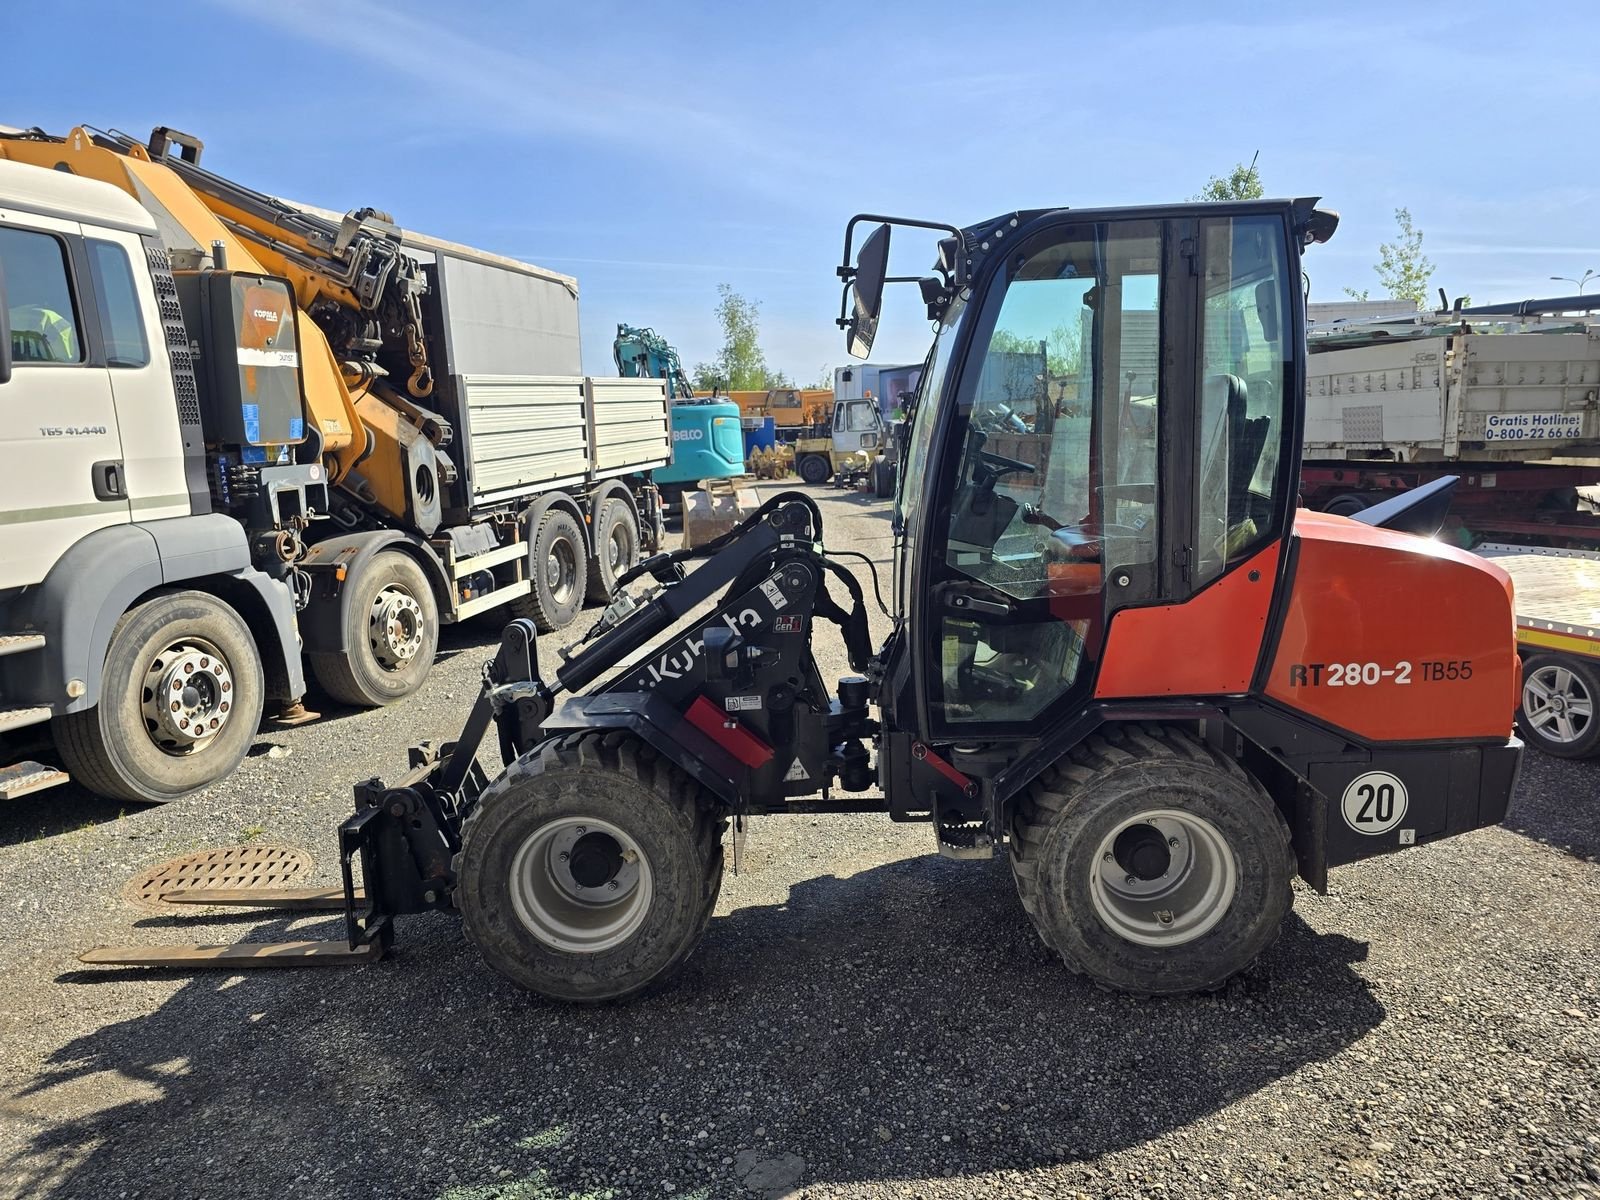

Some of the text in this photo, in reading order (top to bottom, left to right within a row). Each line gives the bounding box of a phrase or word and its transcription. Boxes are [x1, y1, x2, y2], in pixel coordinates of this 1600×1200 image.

[1489, 415, 1528, 426] Gratis
[1532, 414, 1580, 426] Hotline:
[40, 426, 106, 436] TGS 41.440
[1486, 427, 1580, 440] 0-800-22 66 66
[647, 608, 763, 684] Kubta
[1421, 661, 1473, 682] TB55
[1355, 783, 1396, 823] 20
